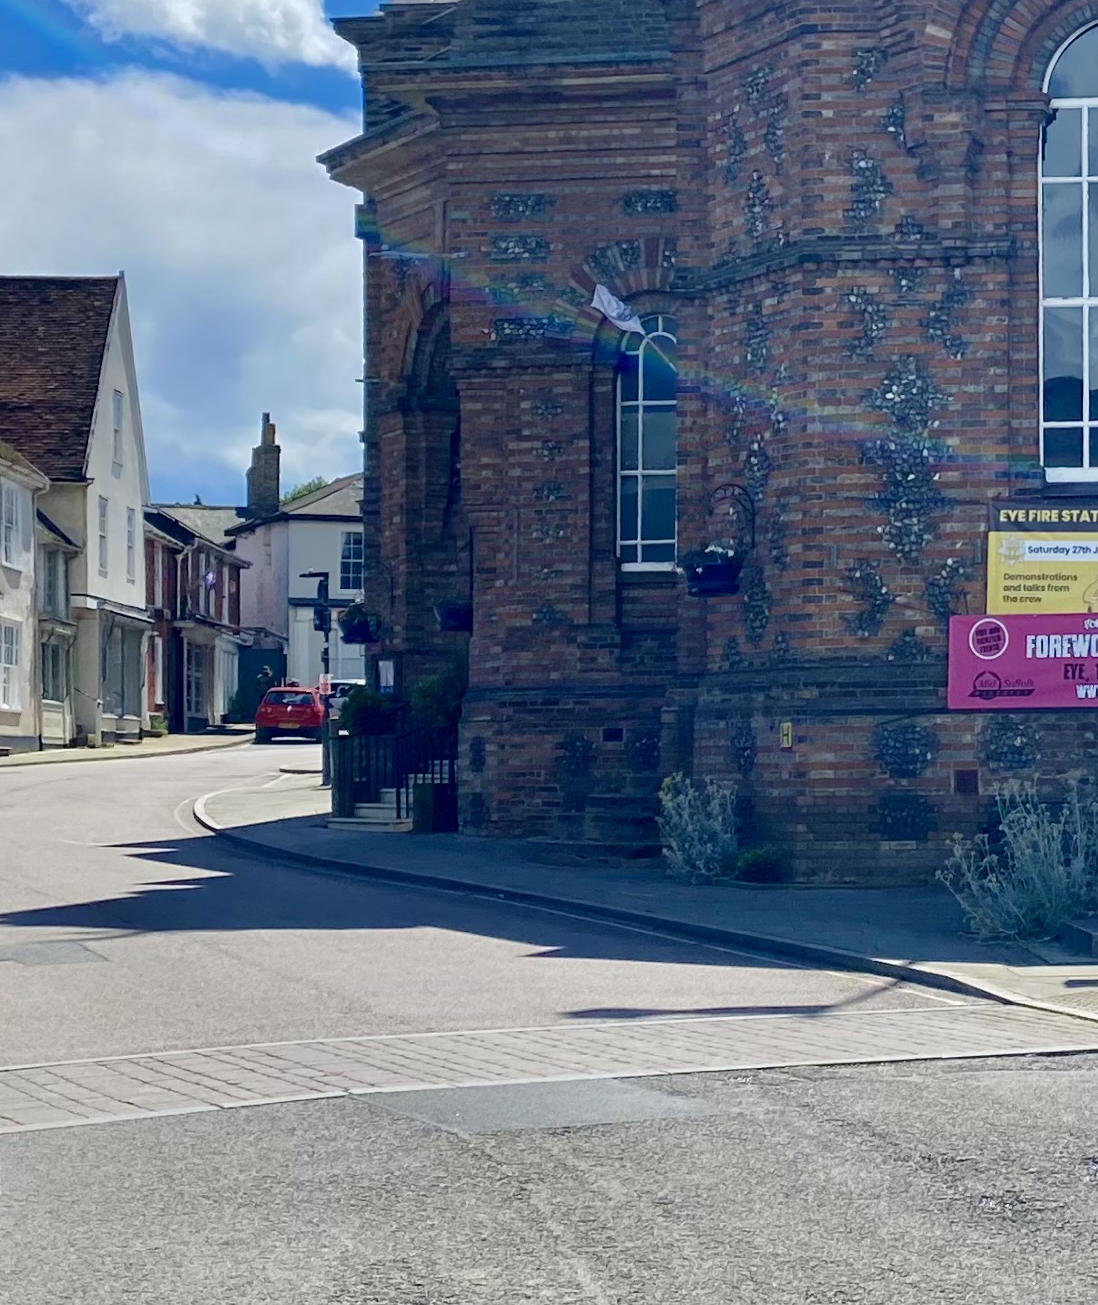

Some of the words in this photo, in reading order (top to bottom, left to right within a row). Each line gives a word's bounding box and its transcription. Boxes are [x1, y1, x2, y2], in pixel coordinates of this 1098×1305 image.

[999, 509, 1025, 523] EYE
[1028, 509, 1059, 523] FIRE
[1027, 545, 1070, 556] Saturday
[1071, 545, 1092, 555] 27th
[1003, 572, 1078, 582] Demonstrations
[1003, 583, 1022, 592] and
[1023, 583, 1046, 592] talks
[1047, 583, 1070, 592] from
[1002, 594, 1018, 603] the
[1019, 595, 1042, 603] crew
[1063, 663, 1090, 682] EYE,
[1002, 678, 1035, 688] Suffolk
